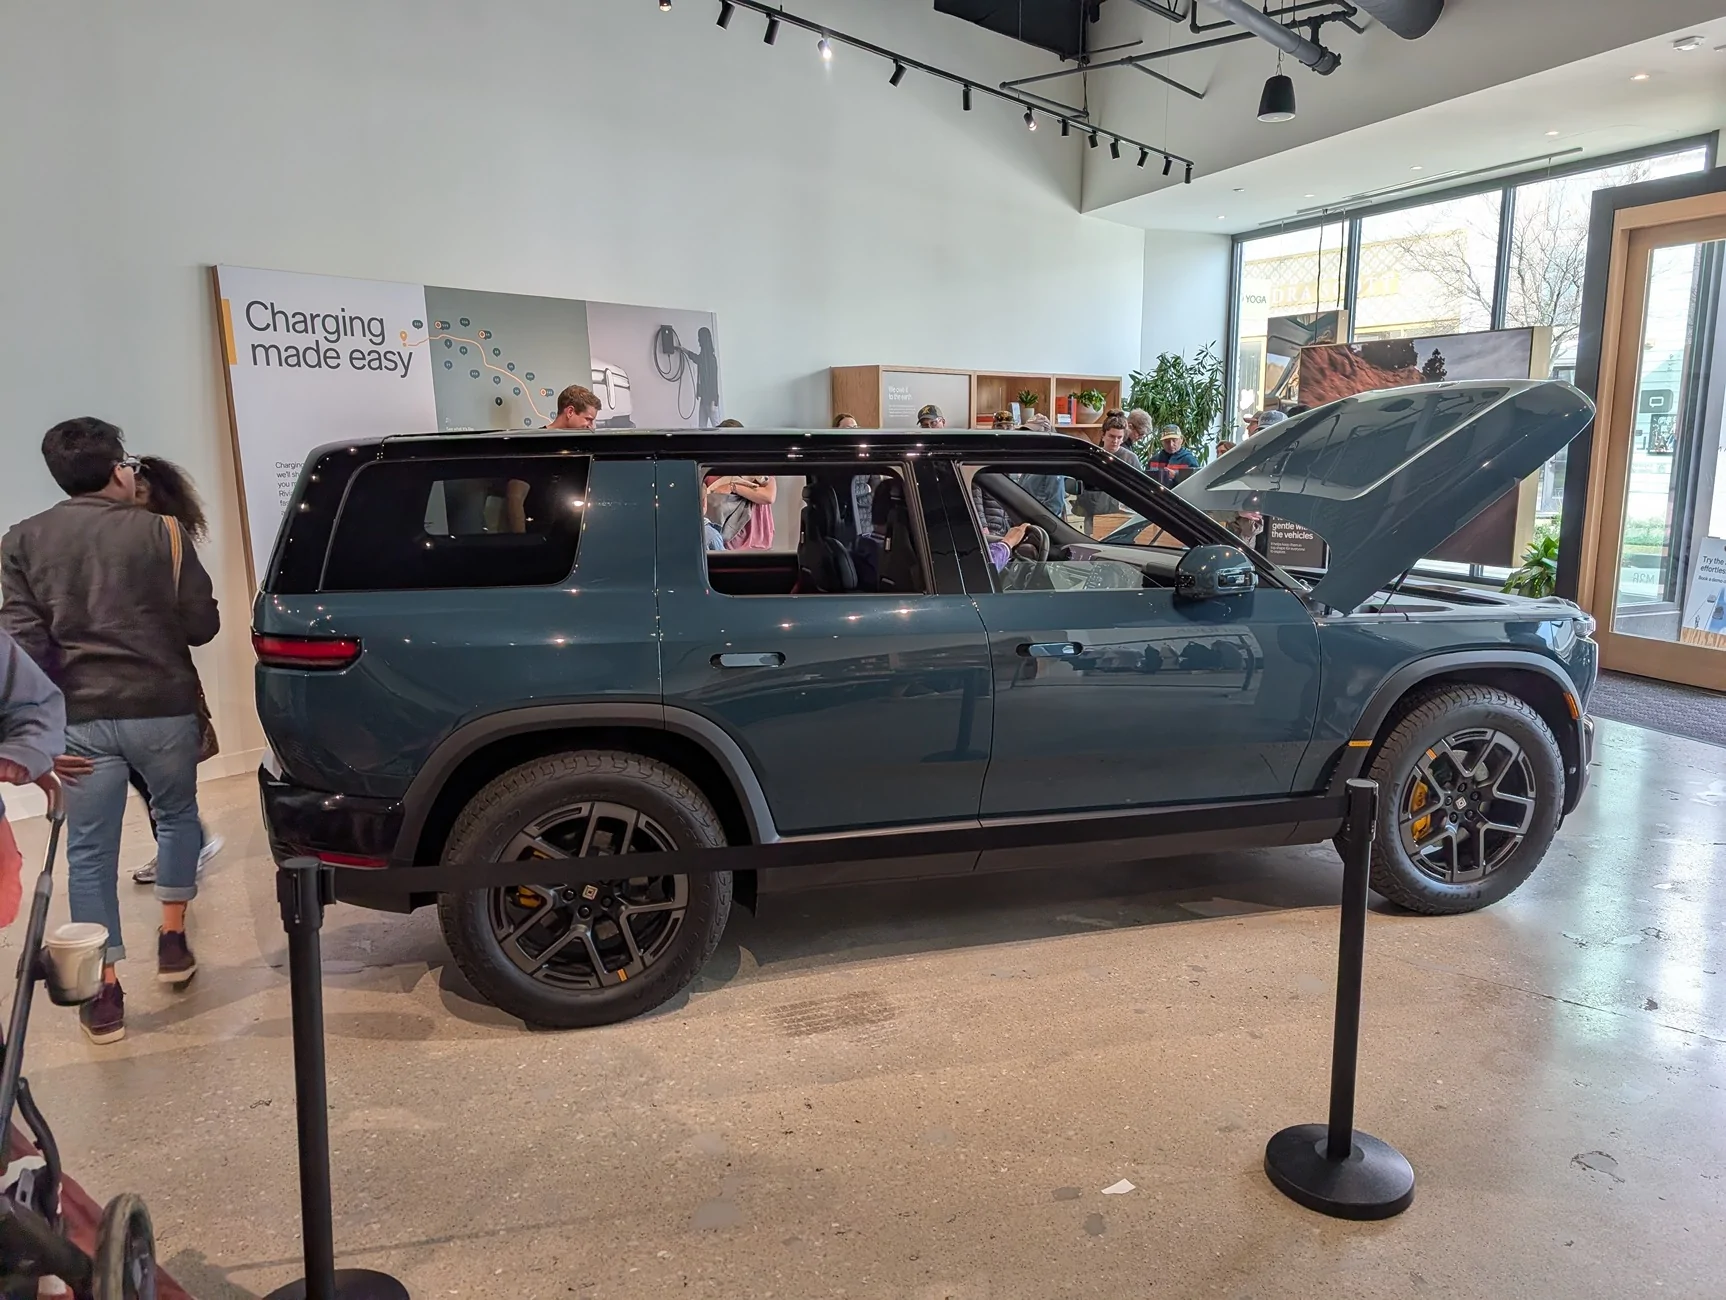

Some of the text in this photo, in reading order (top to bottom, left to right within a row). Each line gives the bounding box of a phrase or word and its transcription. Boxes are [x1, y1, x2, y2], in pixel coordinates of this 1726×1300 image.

[1320, 277, 1396, 299] SCTT
[1246, 294, 1267, 303] YOGA
[245, 300, 386, 346] Charging
[250, 340, 413, 379] made easy
[1272, 522, 1295, 531] gentle
[1271, 530, 1313, 539] the vehicles
[1703, 556, 1713, 564] Try
[1700, 565, 1726, 574] effortles
